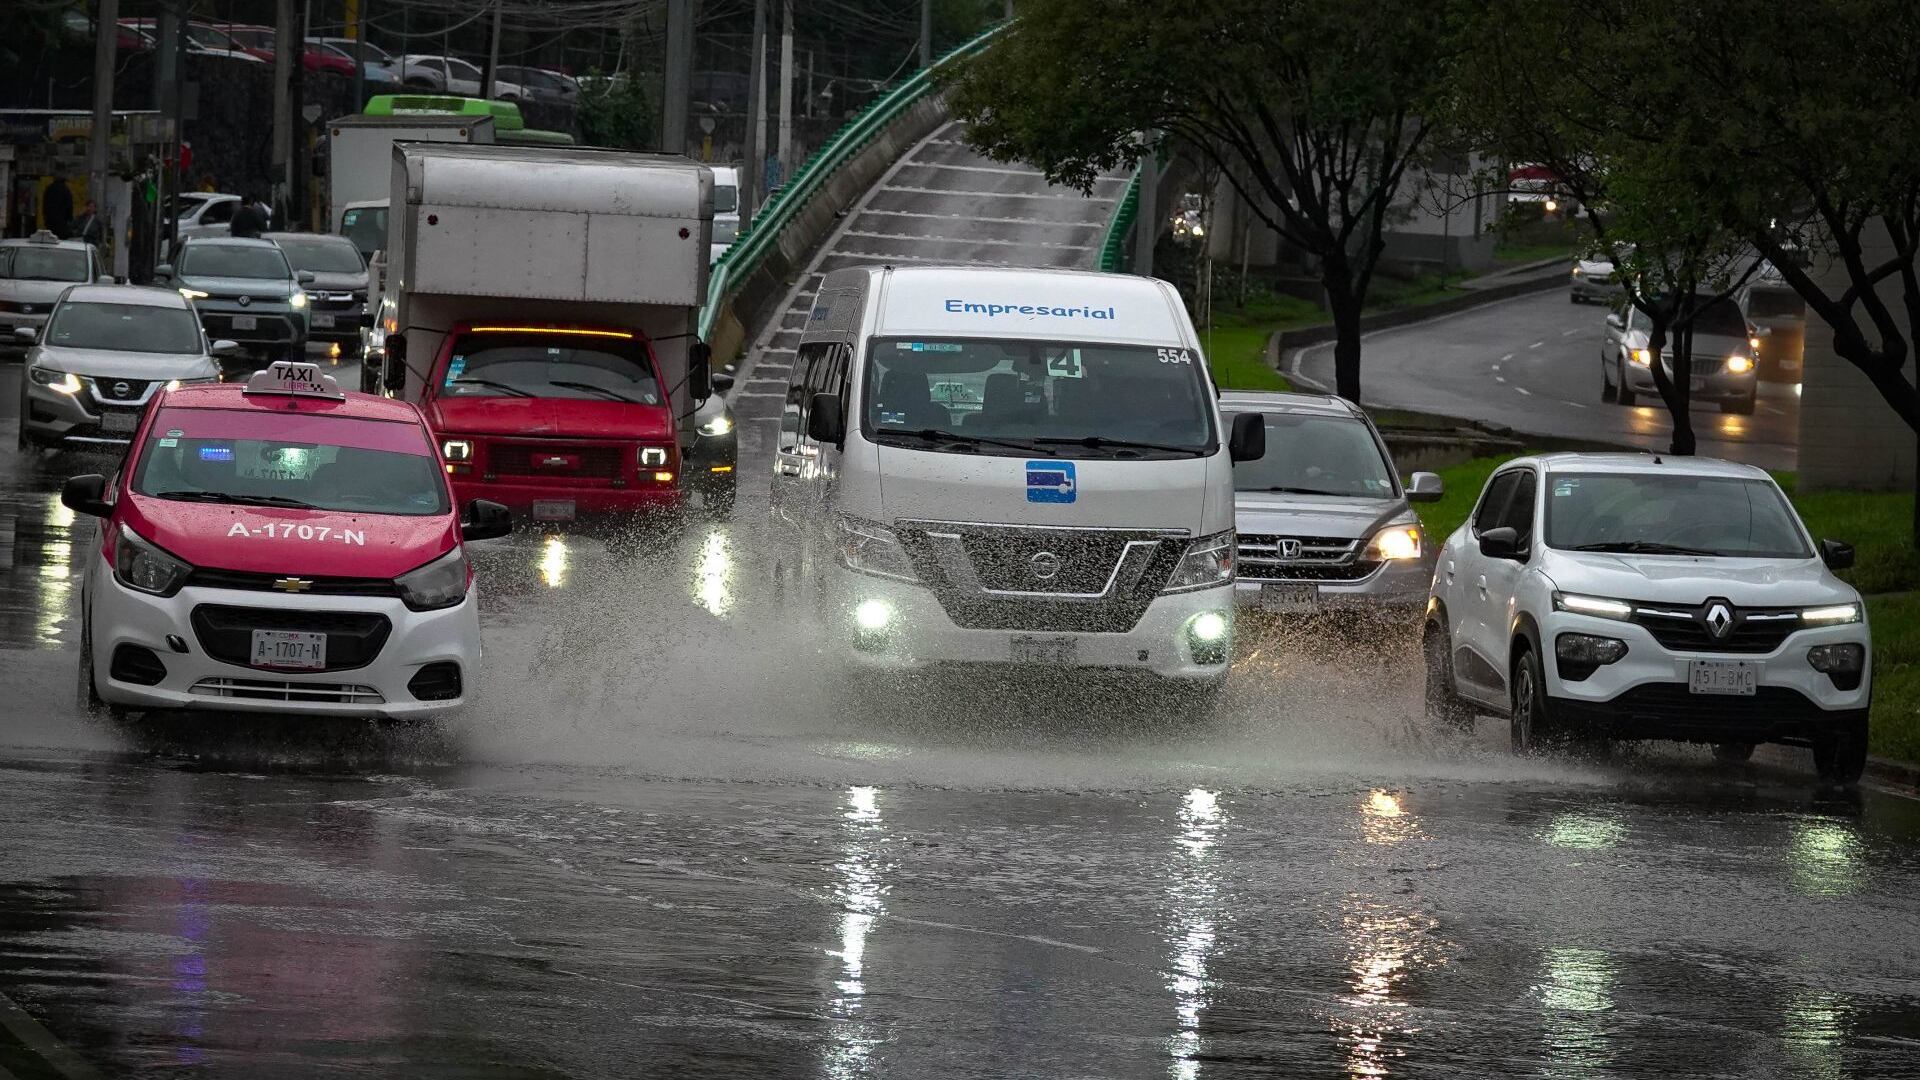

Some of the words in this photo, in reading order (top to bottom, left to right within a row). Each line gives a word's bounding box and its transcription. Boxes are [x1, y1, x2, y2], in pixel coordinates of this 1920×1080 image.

[945, 300, 1115, 320] Empresarial
[1050, 350, 1080, 376] 4
[1157, 348, 1191, 364] 554
[274, 367, 313, 382] TAXI
[283, 382, 308, 391] LIBRE
[939, 384, 962, 393] TAXI
[227, 522, 365, 546] A-1707-N
[258, 640, 320, 659] A-1707-N
[1695, 669, 1752, 686] A51-BMC
